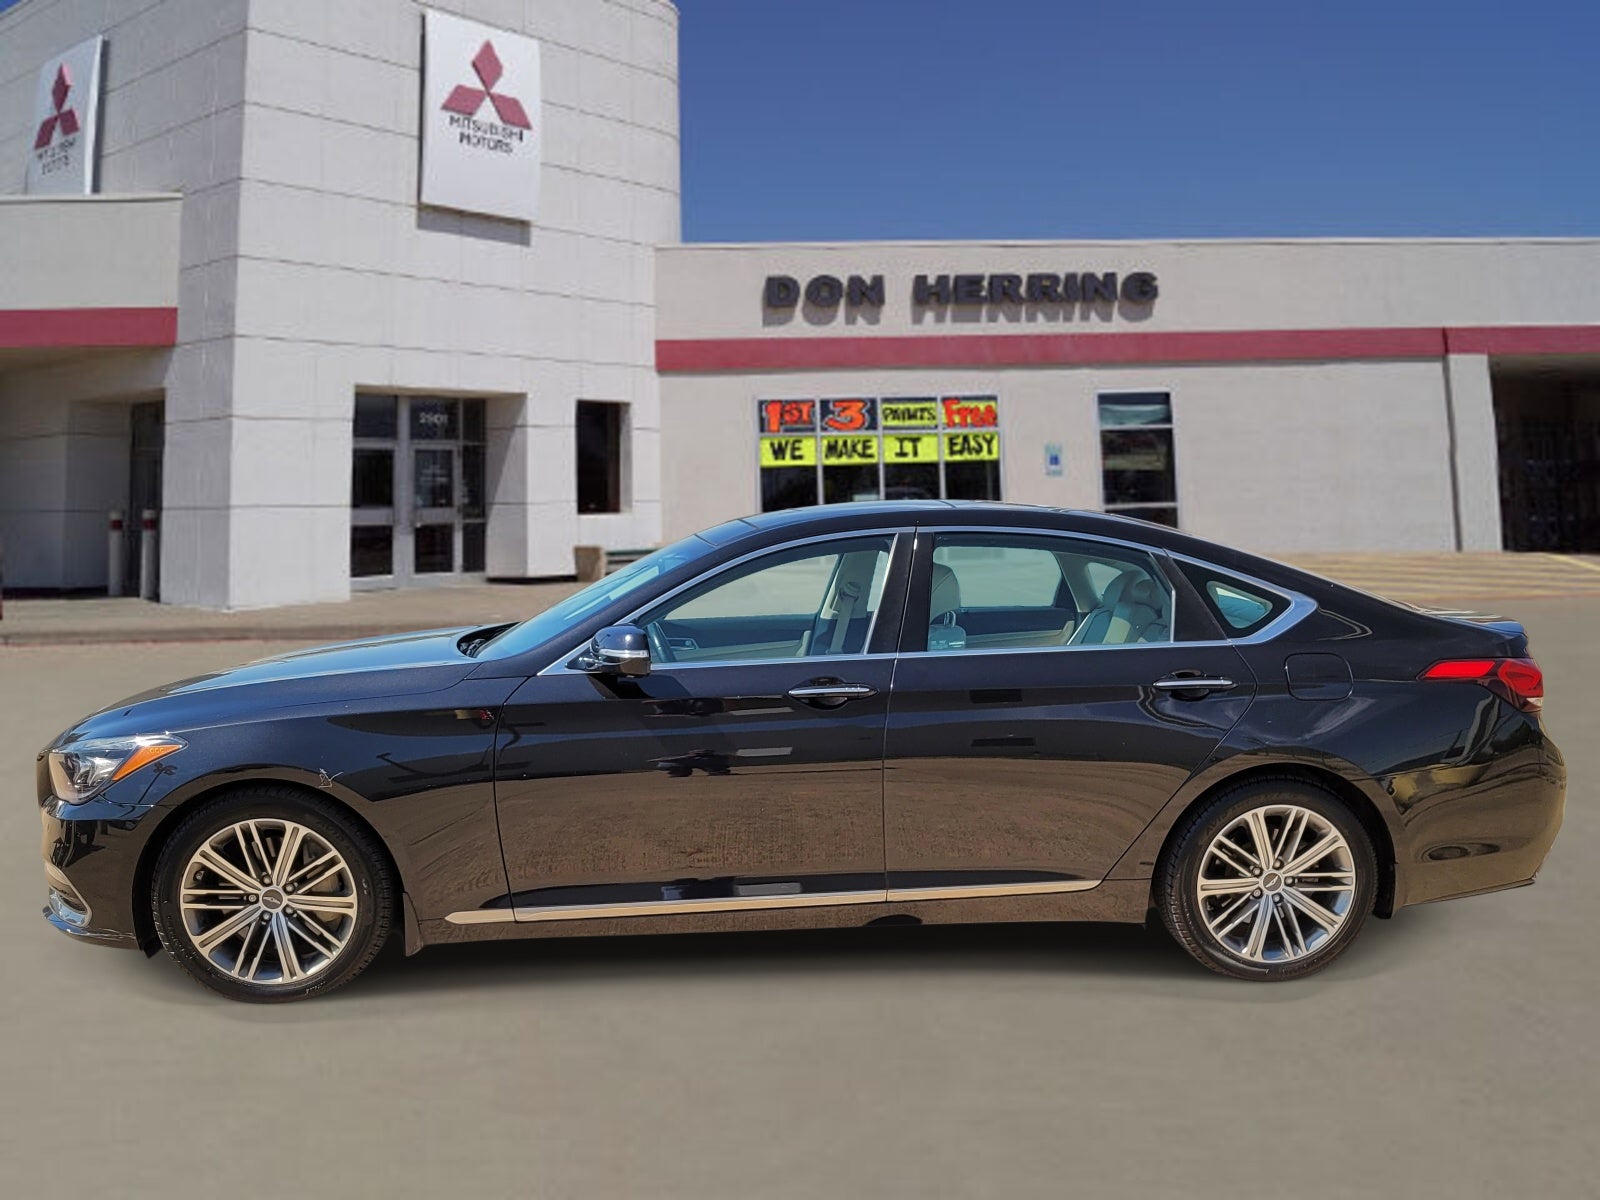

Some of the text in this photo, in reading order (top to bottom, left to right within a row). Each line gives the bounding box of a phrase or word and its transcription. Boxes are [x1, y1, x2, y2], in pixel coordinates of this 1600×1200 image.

[449, 115, 523, 142] MITSUBISHI
[459, 132, 513, 154] MOTORS
[765, 271, 1159, 308] DON HERRING
[825, 399, 867, 432] 3
[769, 434, 995, 460] WE MAKE IT EASY
